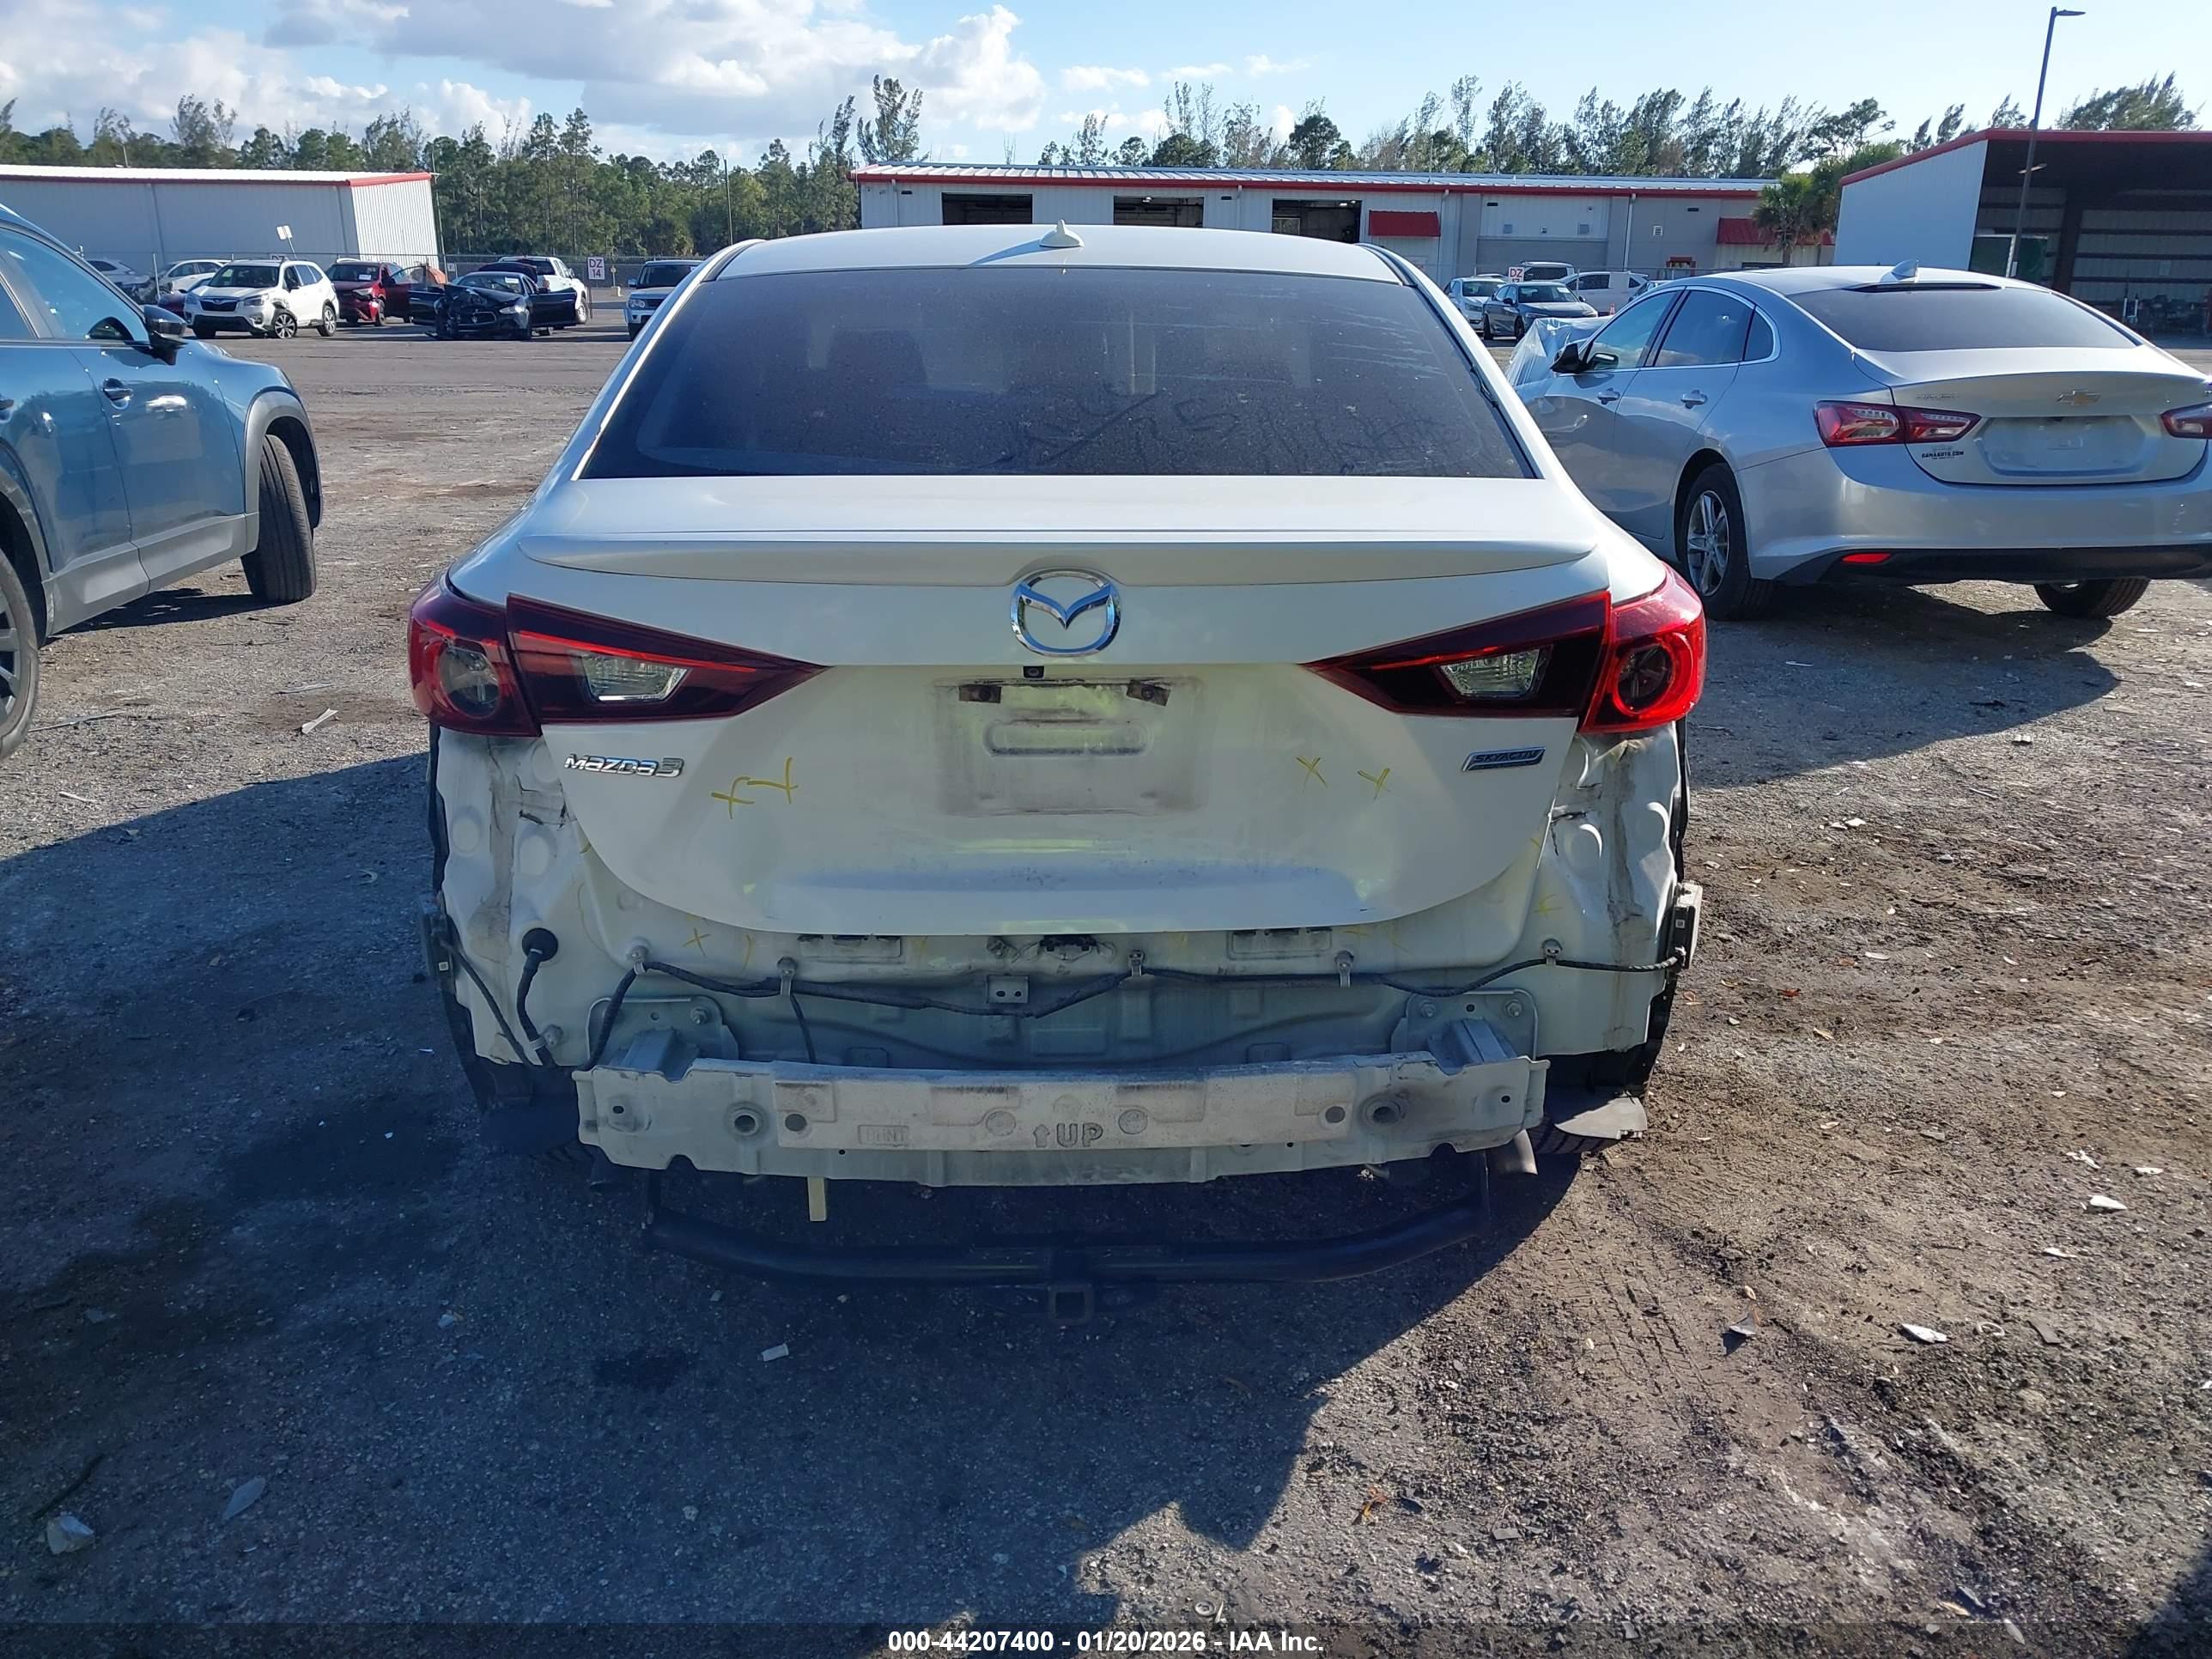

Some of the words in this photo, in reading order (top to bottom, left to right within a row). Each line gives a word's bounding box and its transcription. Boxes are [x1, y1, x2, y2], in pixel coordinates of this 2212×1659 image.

[589, 258, 603, 268] DZ
[592, 269, 601, 278] 14
[1510, 268, 1523, 277] DZ
[1056, 1121, 1103, 1148] UP
